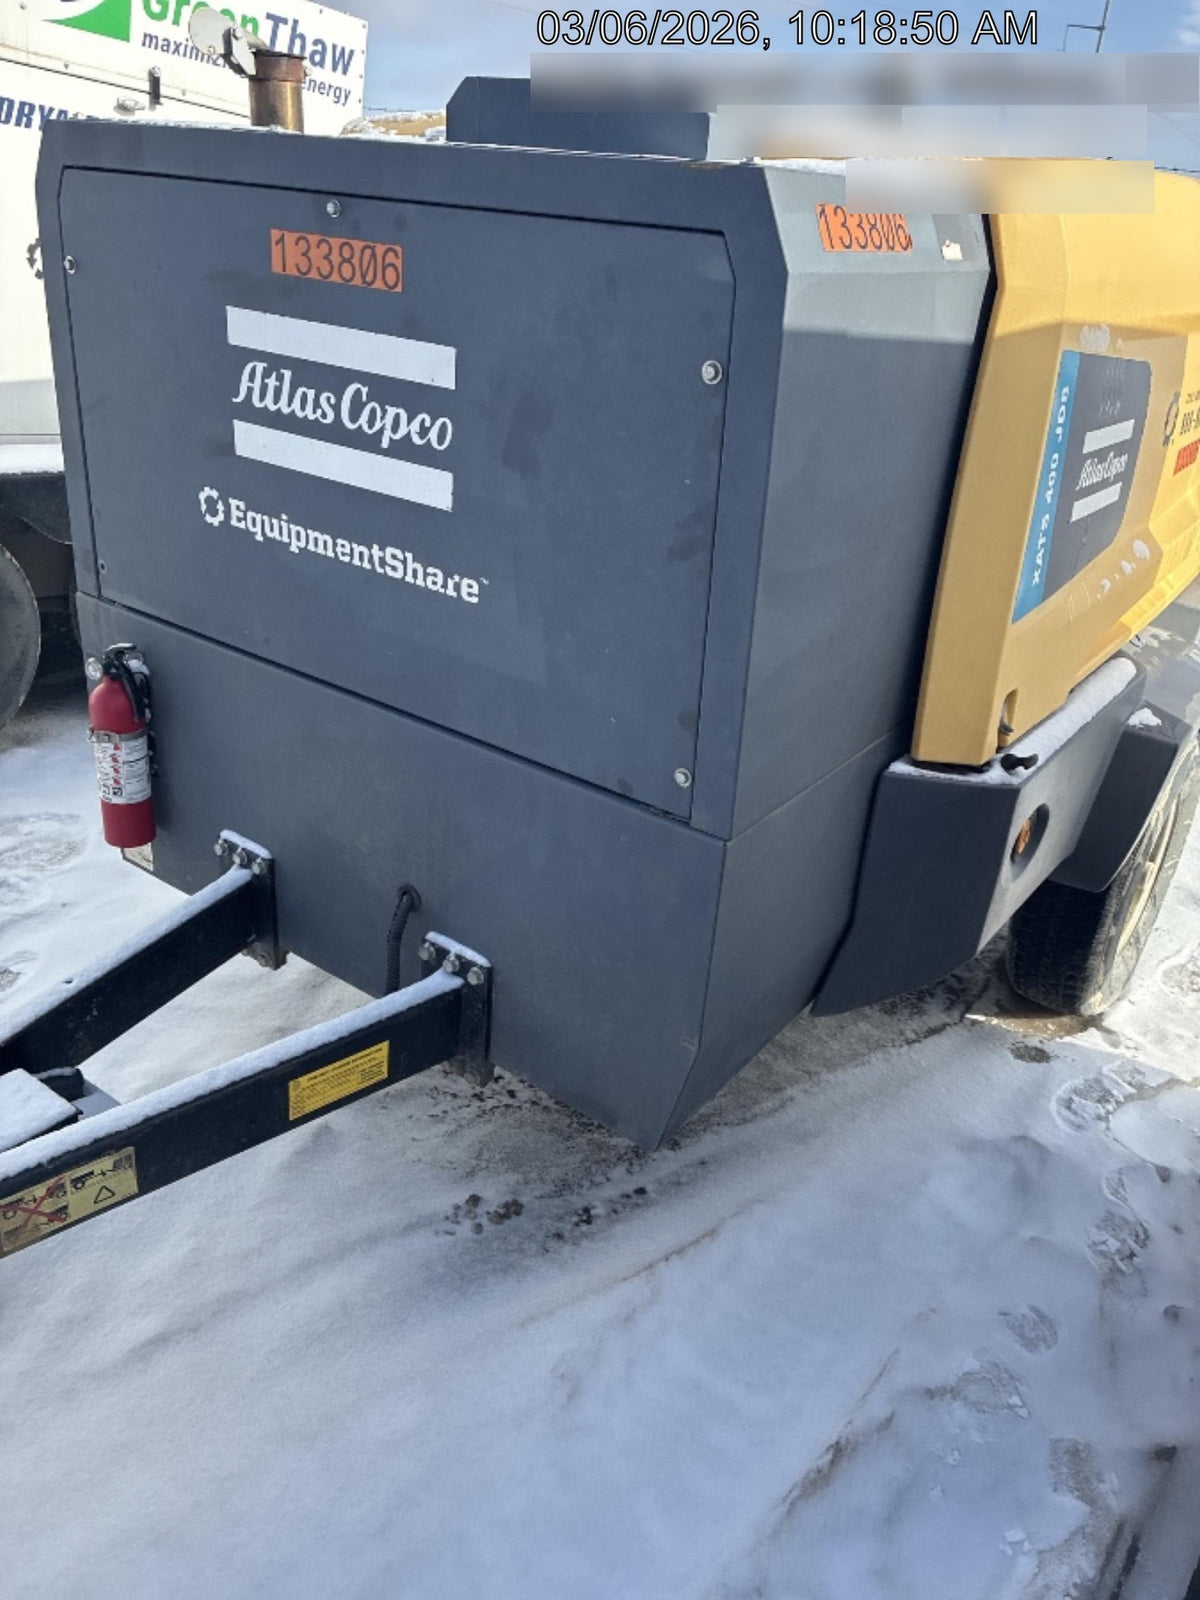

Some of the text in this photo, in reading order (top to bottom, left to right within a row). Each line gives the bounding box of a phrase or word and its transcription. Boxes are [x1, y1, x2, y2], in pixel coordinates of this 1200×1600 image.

[143, 0, 355, 76] GrnThaw
[274, 231, 402, 291] 133806
[232, 360, 453, 450] Atlas Copco
[1045, 452, 1059, 504] 400
[228, 496, 479, 604] EquipmentShare
